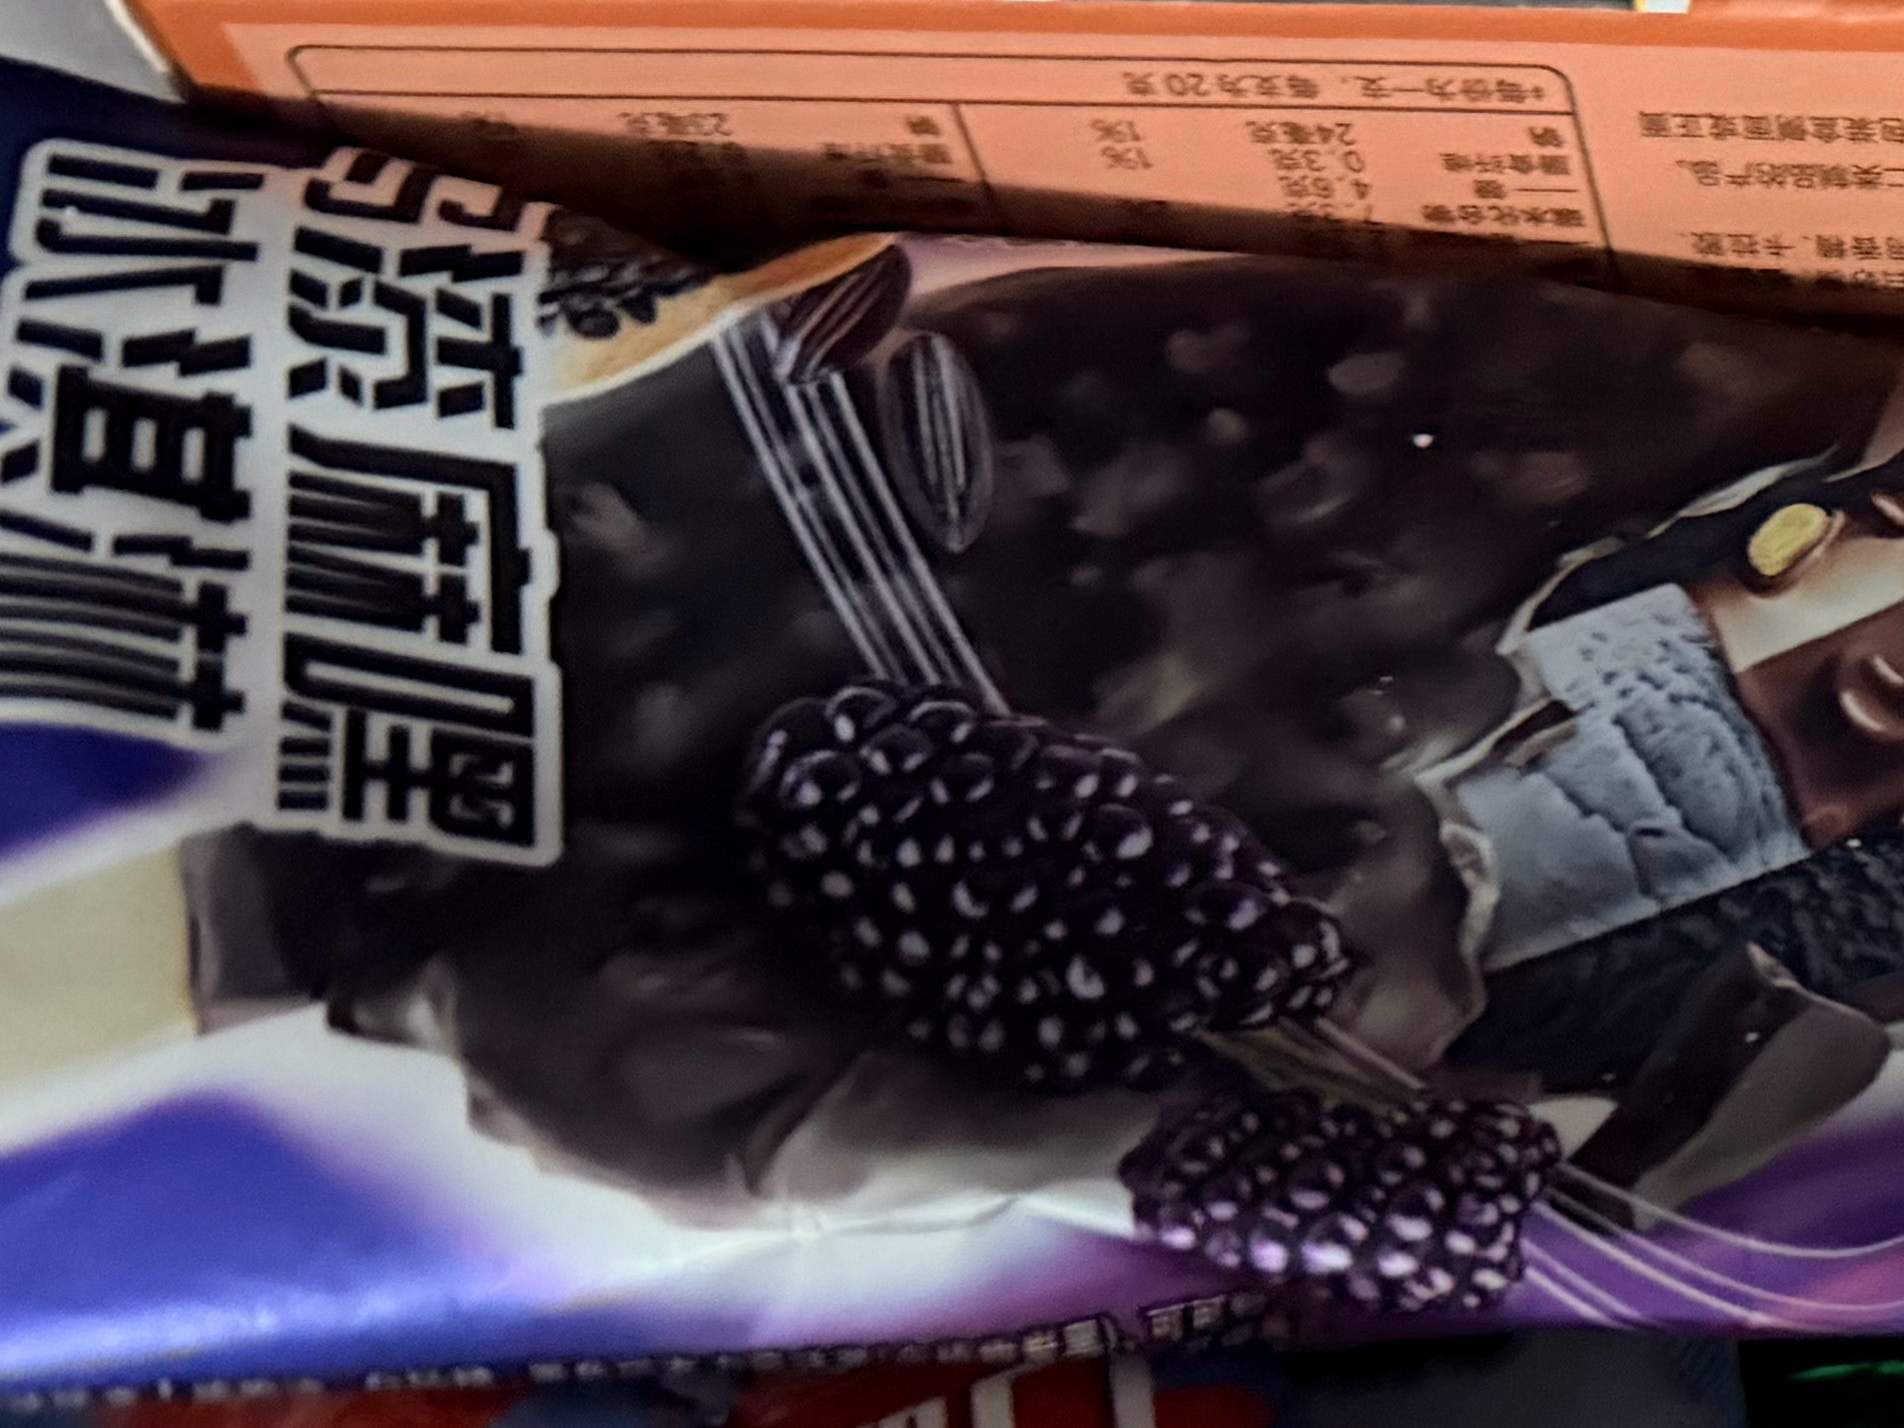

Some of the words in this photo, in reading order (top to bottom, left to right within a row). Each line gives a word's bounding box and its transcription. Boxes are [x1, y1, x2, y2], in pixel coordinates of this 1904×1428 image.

[1088, 118, 1139, 143] 1%
[1244, 118, 1356, 147] 24毫克
[1102, 145, 1154, 171] 1%
[1268, 147, 1363, 175] 0.3克
[1440, 152, 1570, 176] 膳食纤维
[1421, 203, 1585, 229] 碳水化合物
[0, 152, 256, 736] 冰淇淋
